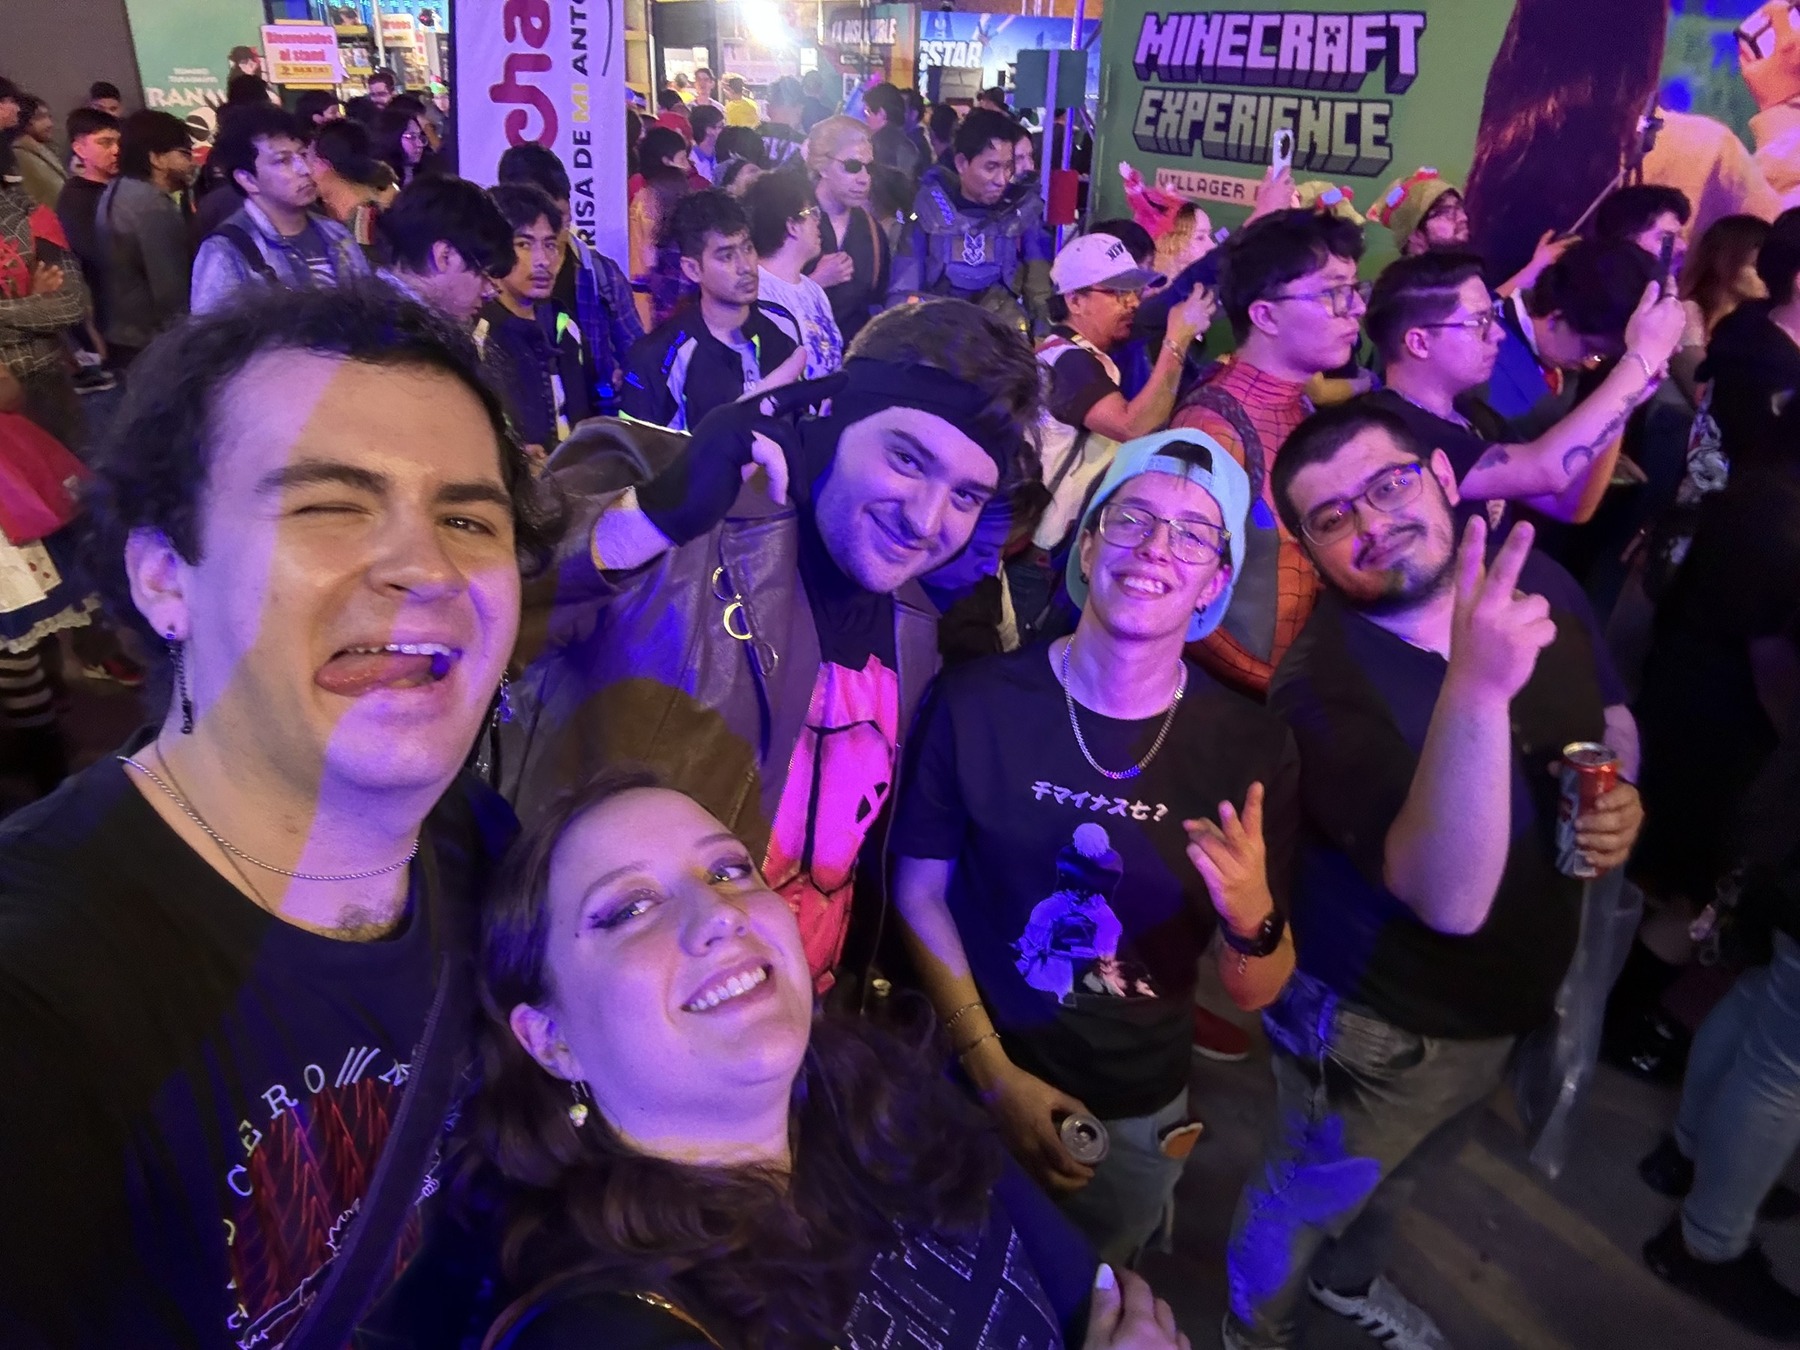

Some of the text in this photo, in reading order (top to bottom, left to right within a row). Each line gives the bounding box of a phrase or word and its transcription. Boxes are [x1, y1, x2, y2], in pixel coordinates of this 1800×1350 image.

[1133, 12, 1426, 94] MINECRAFT
[572, 83, 590, 123] MI
[1133, 86, 1393, 177] EXPERIENCE
[572, 129, 594, 169] DE
